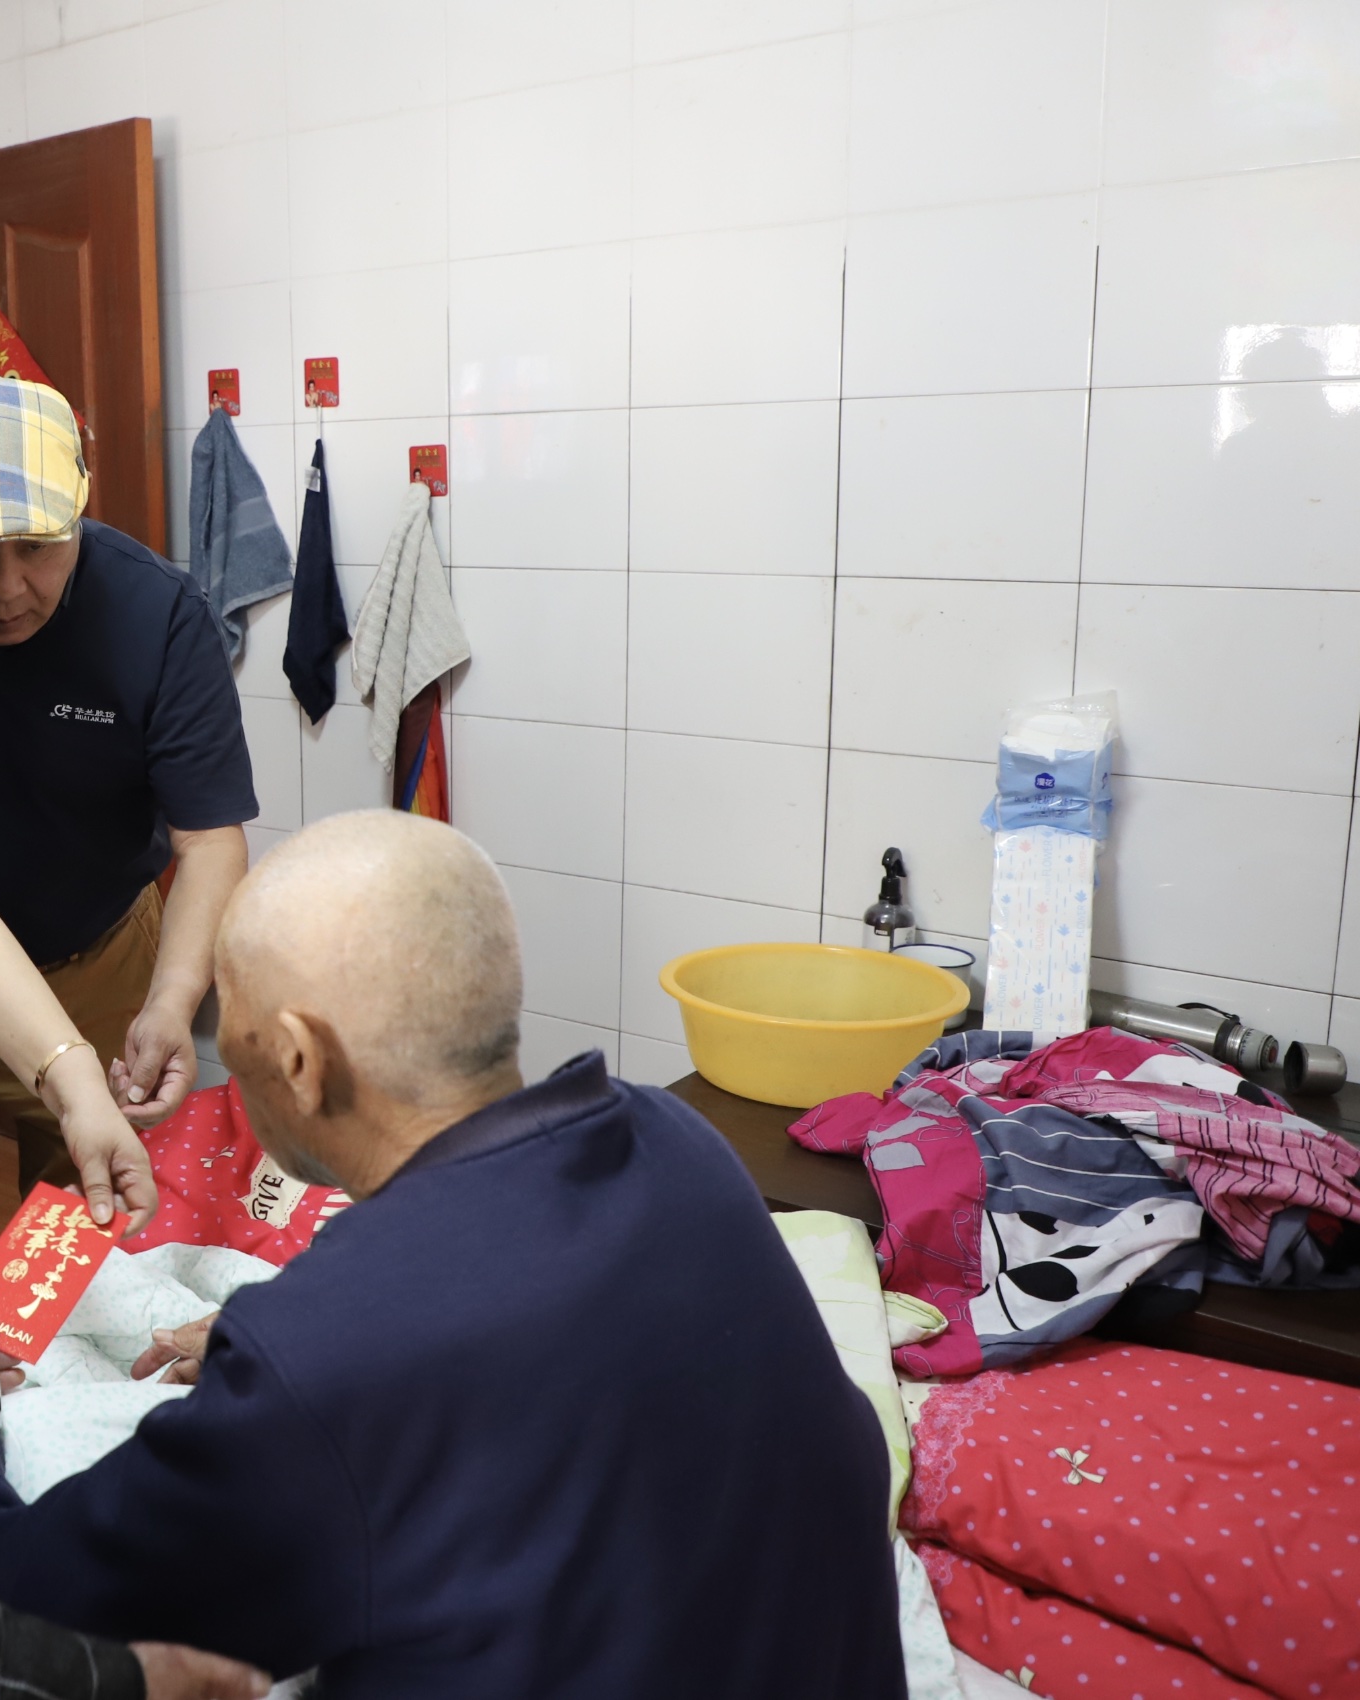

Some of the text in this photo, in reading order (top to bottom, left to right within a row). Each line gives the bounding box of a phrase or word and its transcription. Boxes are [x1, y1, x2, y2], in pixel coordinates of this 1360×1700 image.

[1042, 839, 1053, 877] FLOWER
[1076, 904, 1085, 938] FLOWER
[997, 974, 1007, 1008] FLOWER
[1033, 996, 1043, 1030] LOWER
[252, 1174, 284, 1220] GIVE
